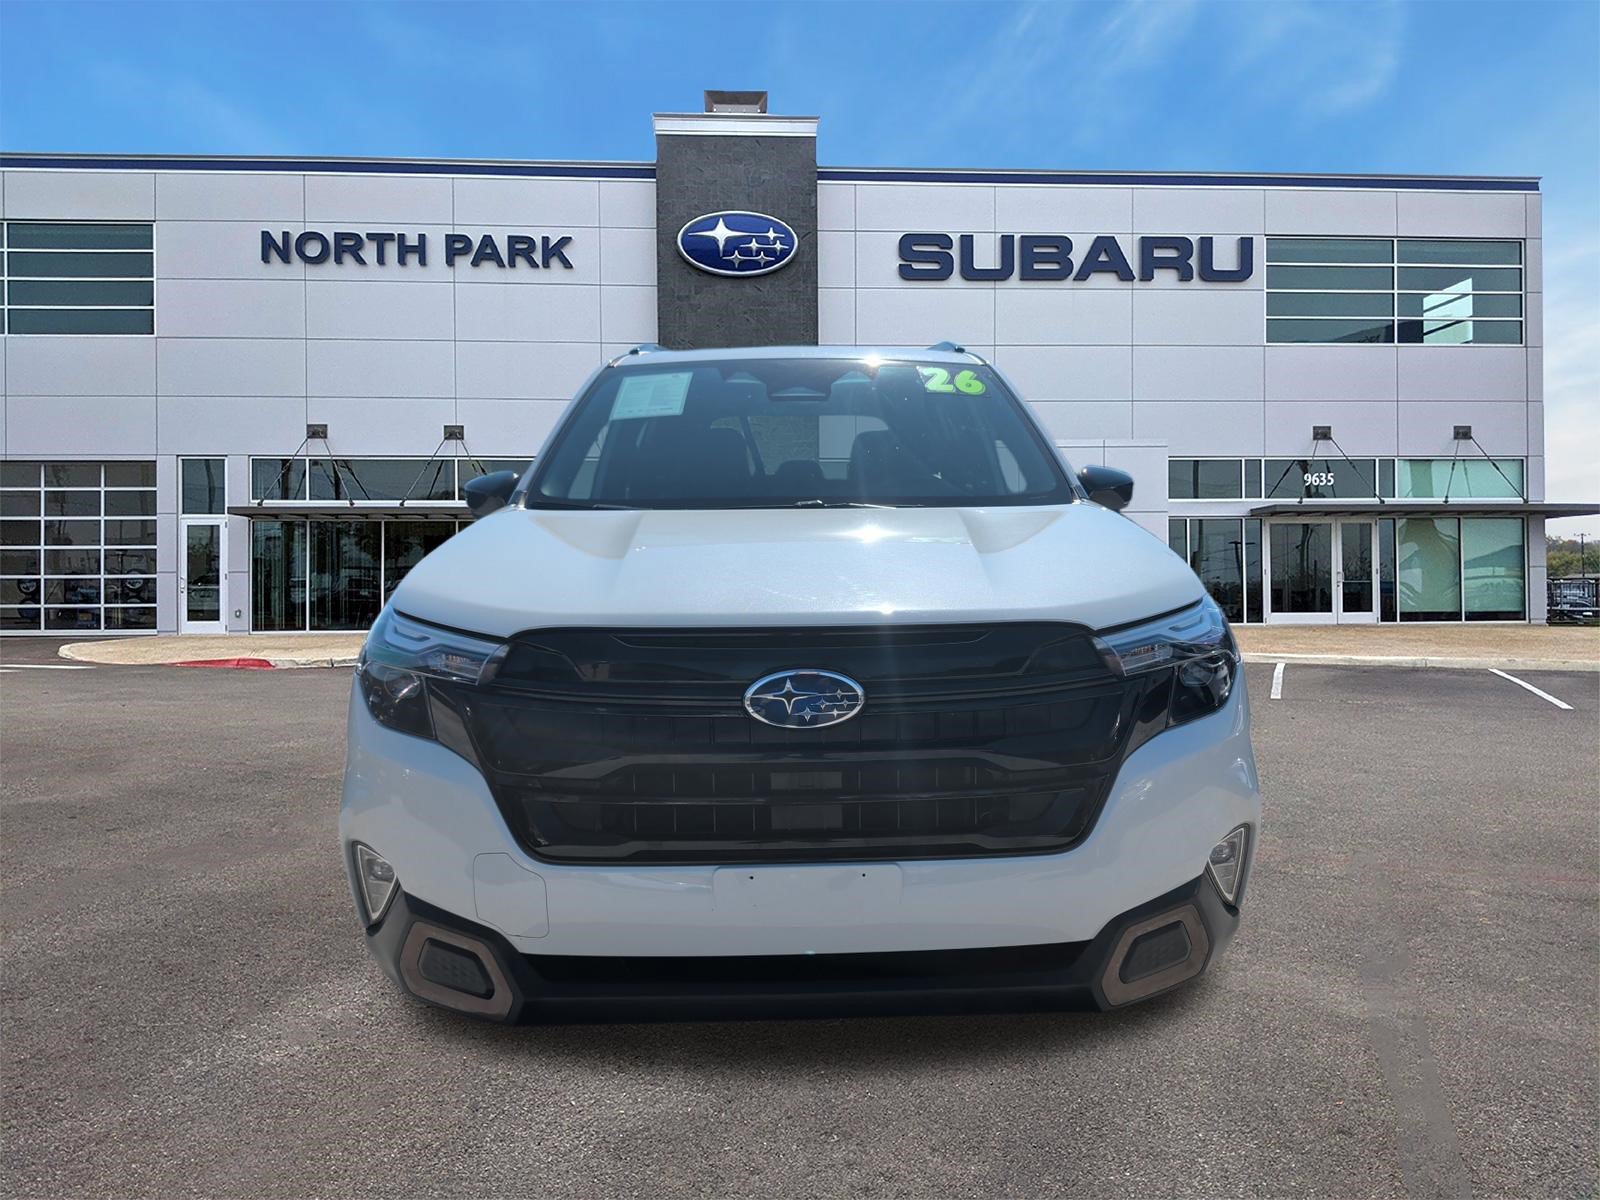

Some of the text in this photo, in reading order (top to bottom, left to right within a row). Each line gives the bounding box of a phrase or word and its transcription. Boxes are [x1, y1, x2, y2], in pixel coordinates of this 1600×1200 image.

[260, 230, 574, 269] NORTH PARK
[898, 232, 1254, 282] SUBARU
[921, 367, 986, 396] 26
[1303, 472, 1335, 486] 9635
